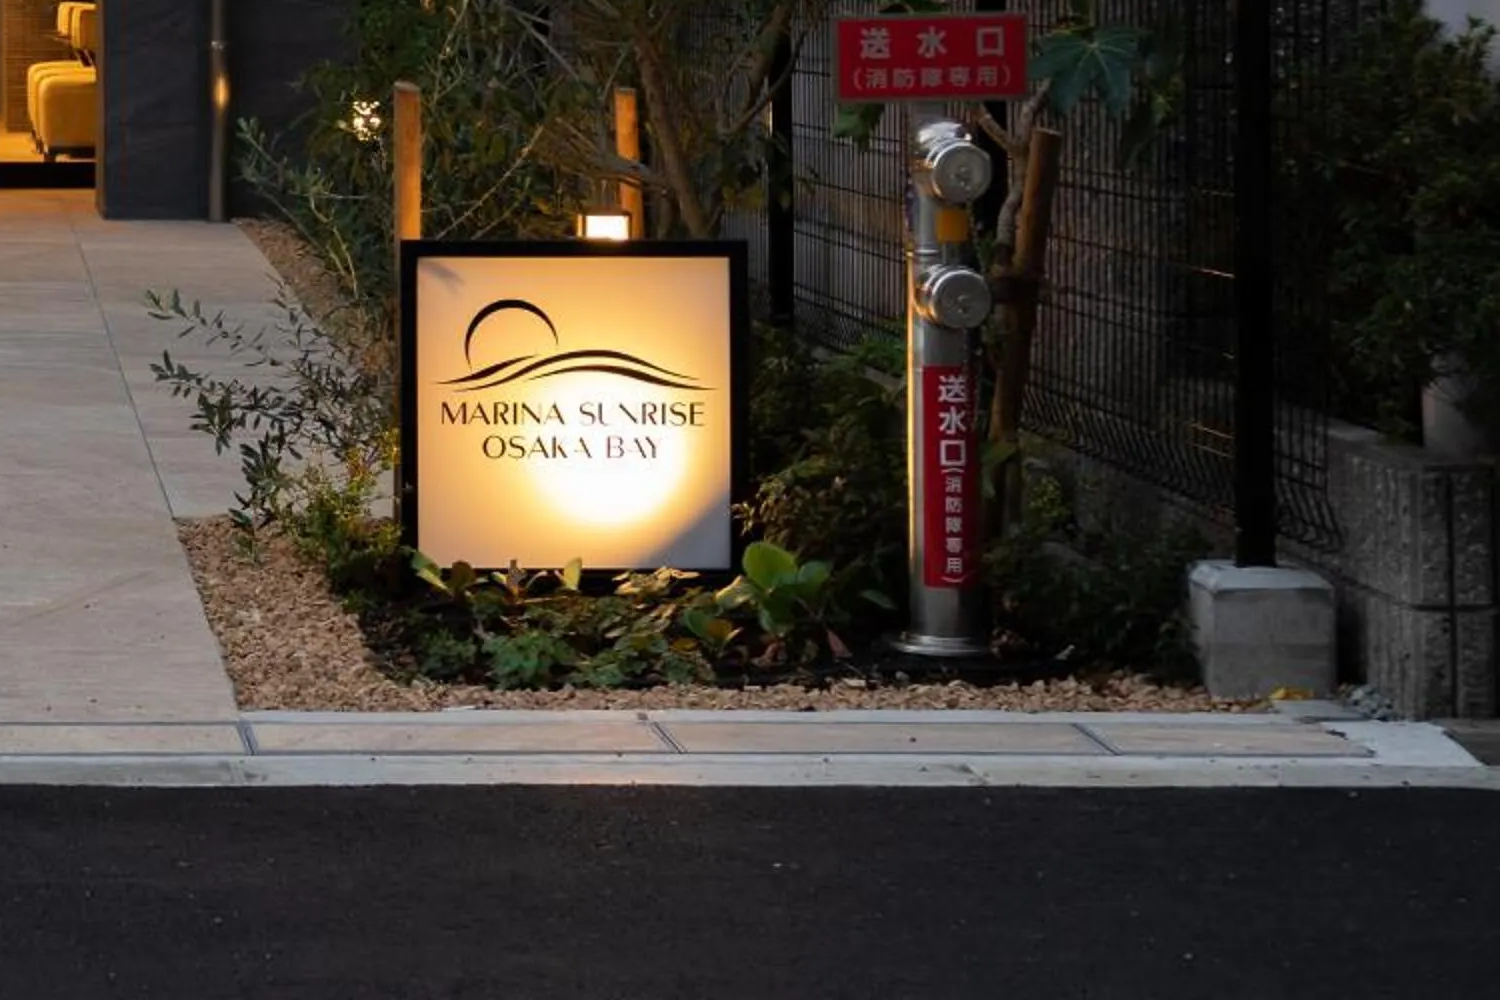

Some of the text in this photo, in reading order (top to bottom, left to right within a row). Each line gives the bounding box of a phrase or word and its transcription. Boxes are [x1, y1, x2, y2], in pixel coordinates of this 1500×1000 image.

[859, 26, 1005, 60] 送水口
[441, 401, 707, 427] MARINA SUNRISE
[482, 434, 665, 460] OSAKA BAY
